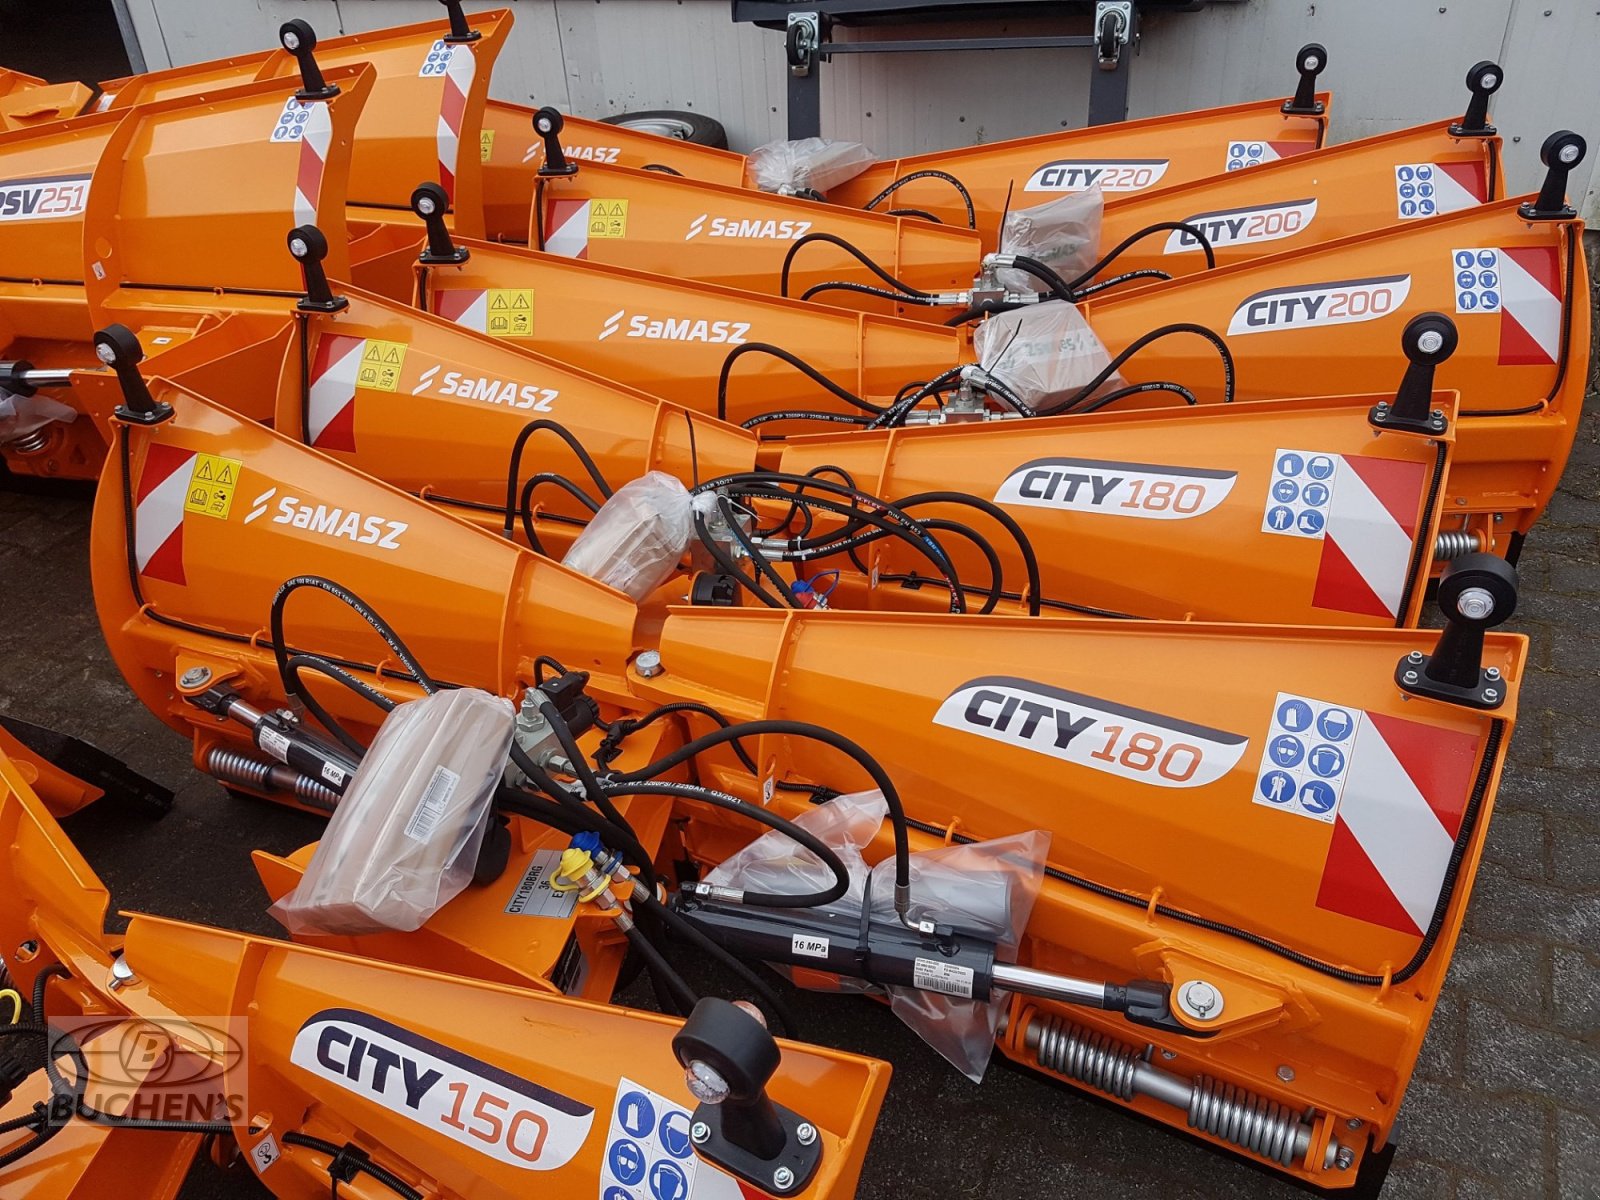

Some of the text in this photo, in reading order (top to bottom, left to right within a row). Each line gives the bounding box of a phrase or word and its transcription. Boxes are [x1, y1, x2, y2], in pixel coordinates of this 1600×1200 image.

[542, 145, 621, 163] MASZ
[708, 218, 812, 240] SaMASZ
[627, 315, 751, 344] SaMASZ
[438, 372, 559, 412] SaMASZ
[272, 496, 409, 550] SaMASZ
[794, 940, 827, 953] 16 MPa
